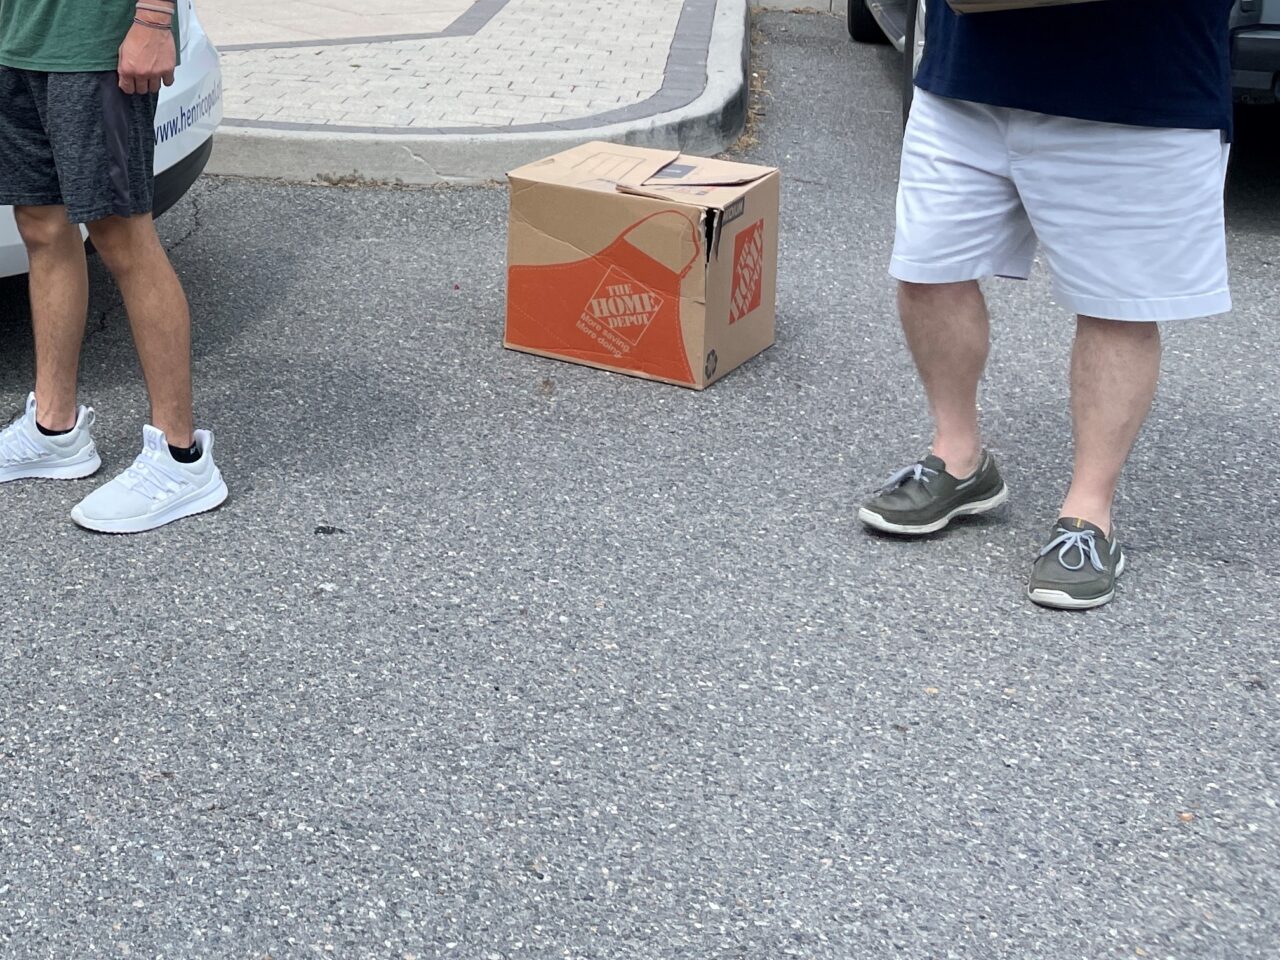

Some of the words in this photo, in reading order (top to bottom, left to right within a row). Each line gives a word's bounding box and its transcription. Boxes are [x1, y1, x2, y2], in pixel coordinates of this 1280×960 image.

[605, 283, 633, 297] THE
[591, 292, 659, 318] HOME
[575, 320, 597, 339] More
[580, 312, 602, 331] More
[608, 313, 650, 328] DEPOT
